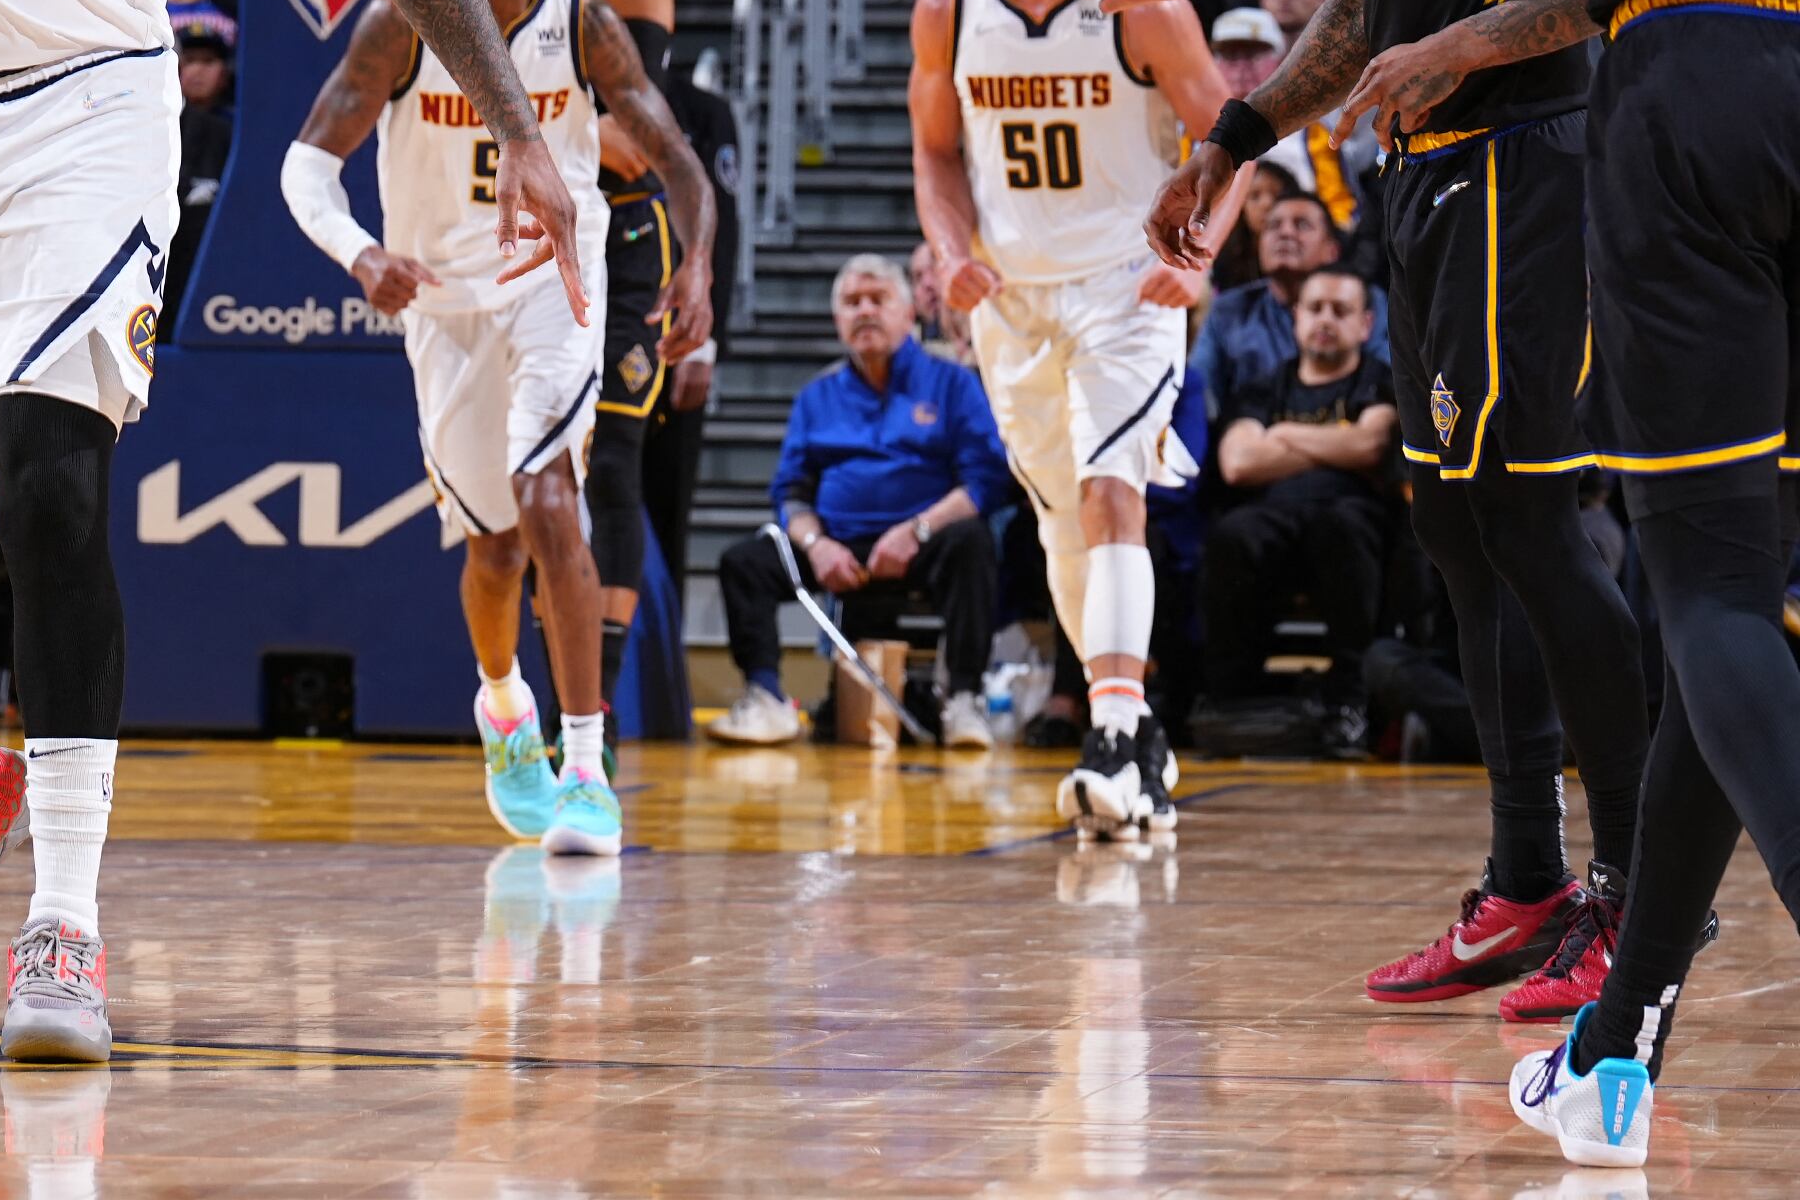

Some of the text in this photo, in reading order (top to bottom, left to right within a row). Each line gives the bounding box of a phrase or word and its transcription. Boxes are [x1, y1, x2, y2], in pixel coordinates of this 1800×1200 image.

[967, 73, 1113, 110] NUGGETS
[1001, 120, 1084, 191] 50
[203, 295, 337, 344] Google
